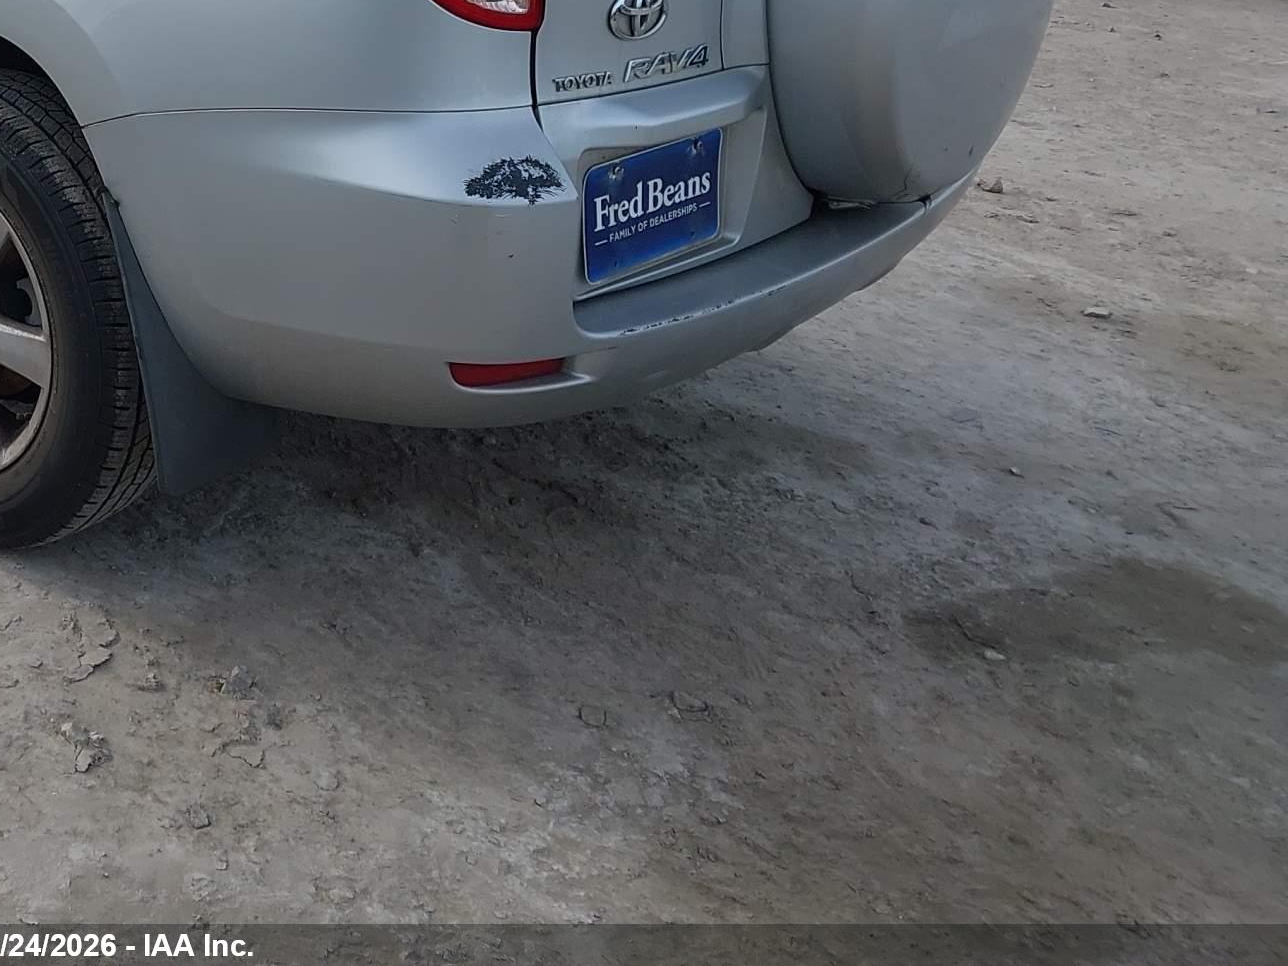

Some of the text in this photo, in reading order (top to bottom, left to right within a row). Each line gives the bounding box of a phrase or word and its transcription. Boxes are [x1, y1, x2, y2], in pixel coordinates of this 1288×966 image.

[552, 43, 709, 92] TOYOTA RAV4
[594, 172, 711, 232] Fred Beans
[609, 202, 698, 242] FAMILY OF DEALERSHIPS
